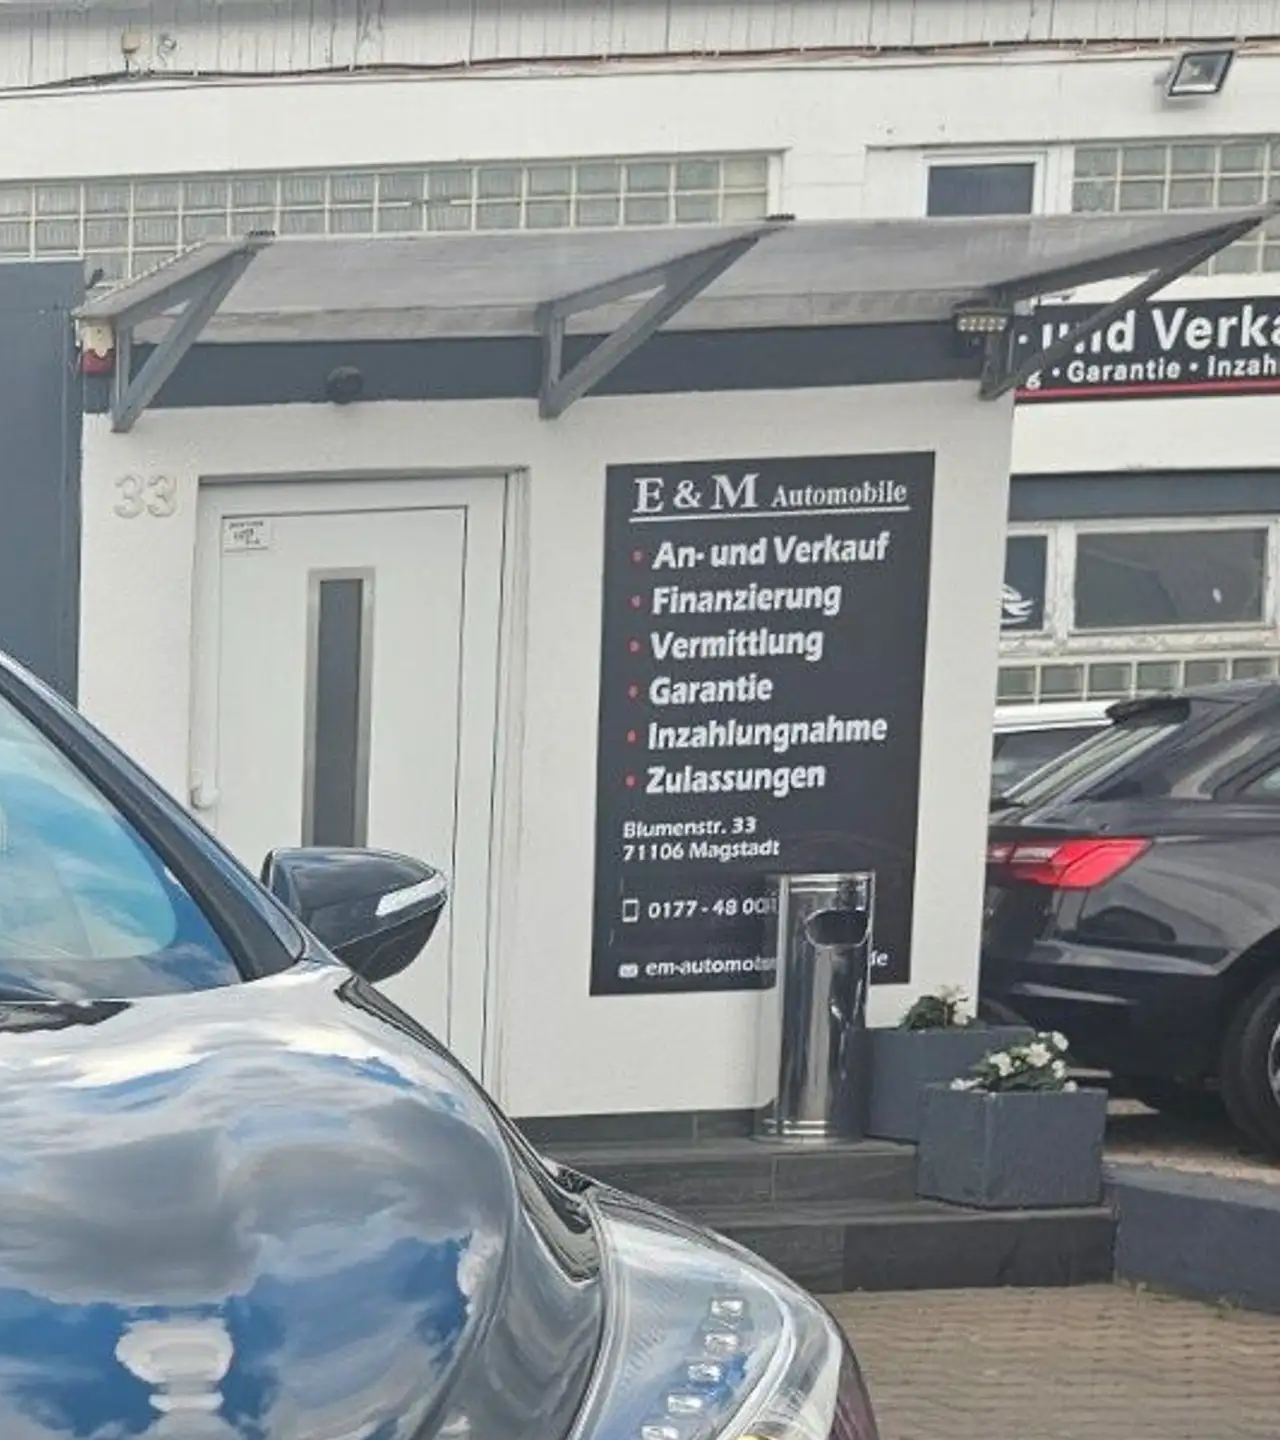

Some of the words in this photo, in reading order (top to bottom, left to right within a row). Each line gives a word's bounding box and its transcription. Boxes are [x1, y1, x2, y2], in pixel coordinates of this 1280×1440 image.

[1066, 357, 1181, 383] Garantie
[113, 473, 178, 519] 33
[769, 480, 908, 508] Automobile
[651, 541, 705, 570] An-
[710, 537, 768, 568] und
[773, 531, 890, 565] Verkauf
[651, 582, 843, 616] Finanzierung
[649, 627, 824, 662] Vermittlung
[648, 672, 774, 705] Garantie
[647, 714, 888, 753] Inzahlungnahme
[645, 764, 827, 798] Zulassungen
[622, 819, 727, 839] Blumenstr.
[731, 815, 758, 835] 33
[622, 844, 685, 862] 71106
[689, 839, 781, 862] Magstadt
[648, 899, 699, 919] 0177
[712, 898, 738, 916] 48
